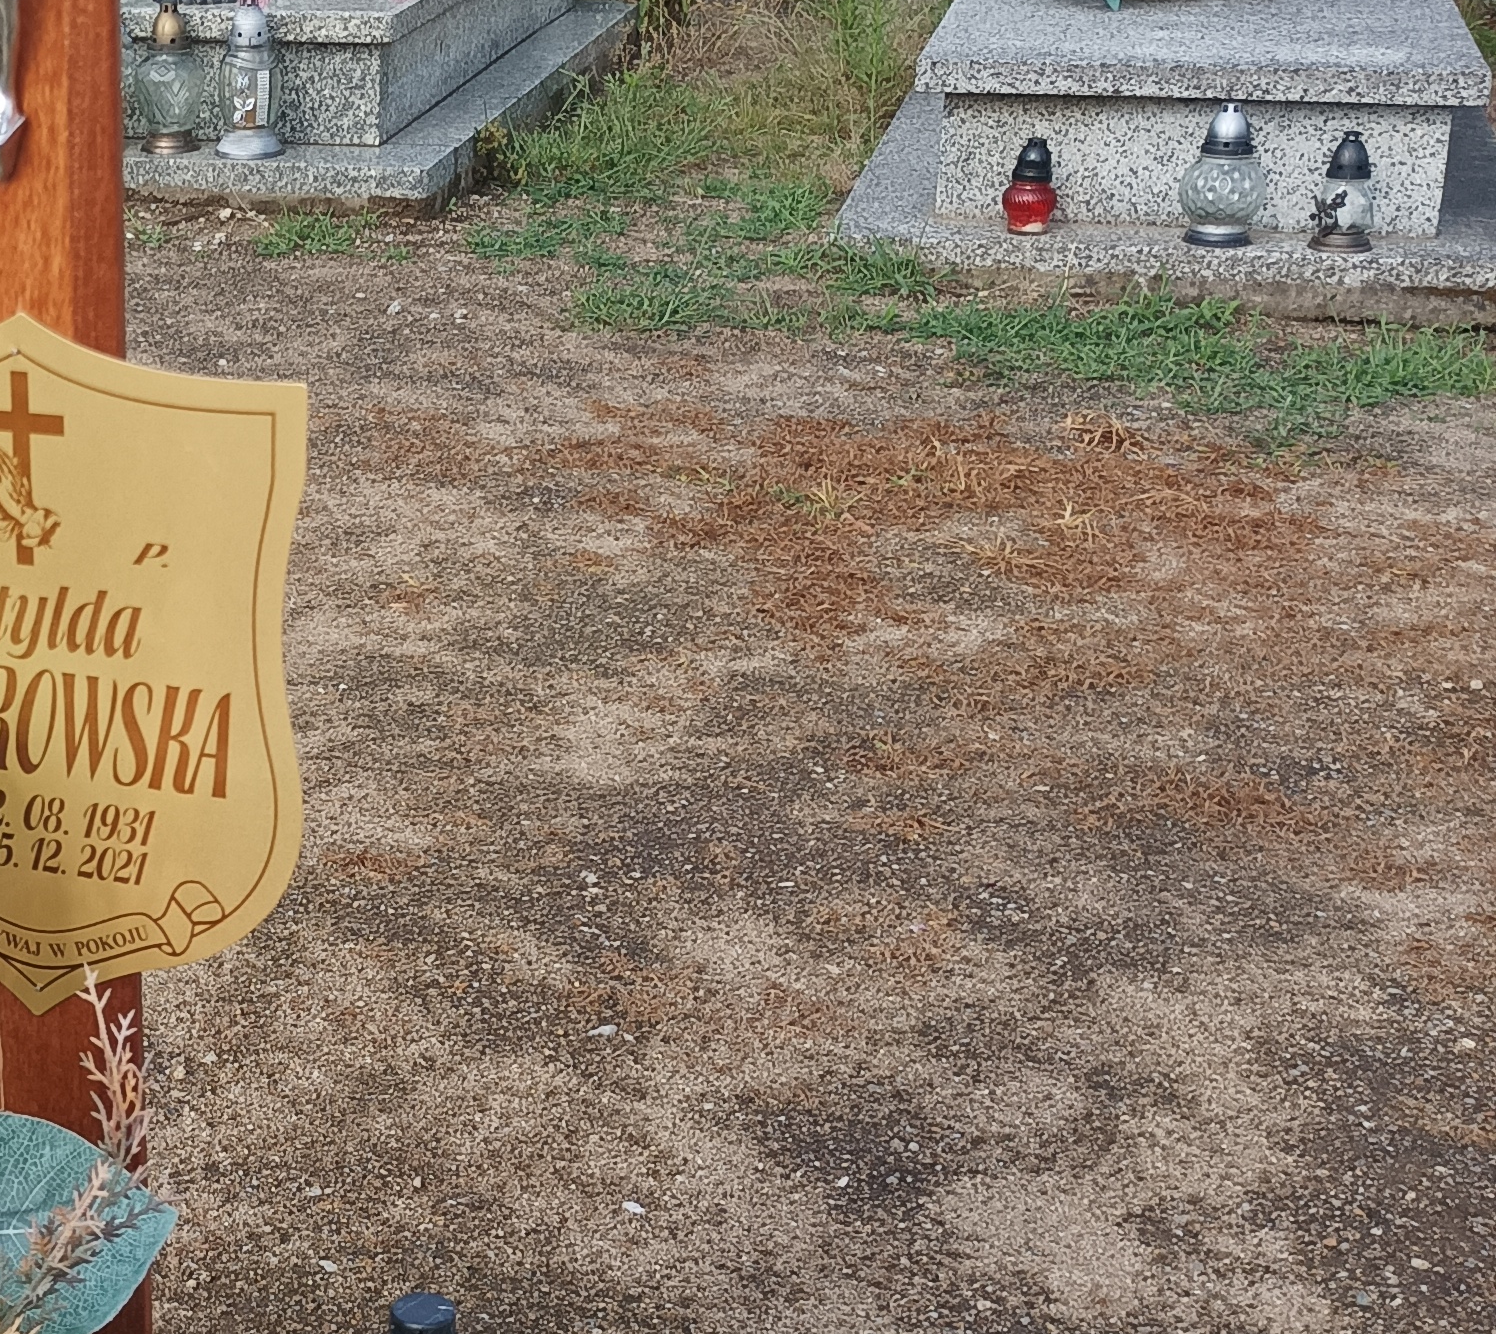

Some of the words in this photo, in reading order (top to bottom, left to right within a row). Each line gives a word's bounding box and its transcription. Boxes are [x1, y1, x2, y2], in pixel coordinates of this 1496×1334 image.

[132, 542, 170, 569] P.
[22, 794, 70, 836] 08.
[82, 802, 157, 847] 1931
[30, 837, 67, 875] 12.
[76, 843, 150, 886] 2021
[47, 942, 67, 959] W
